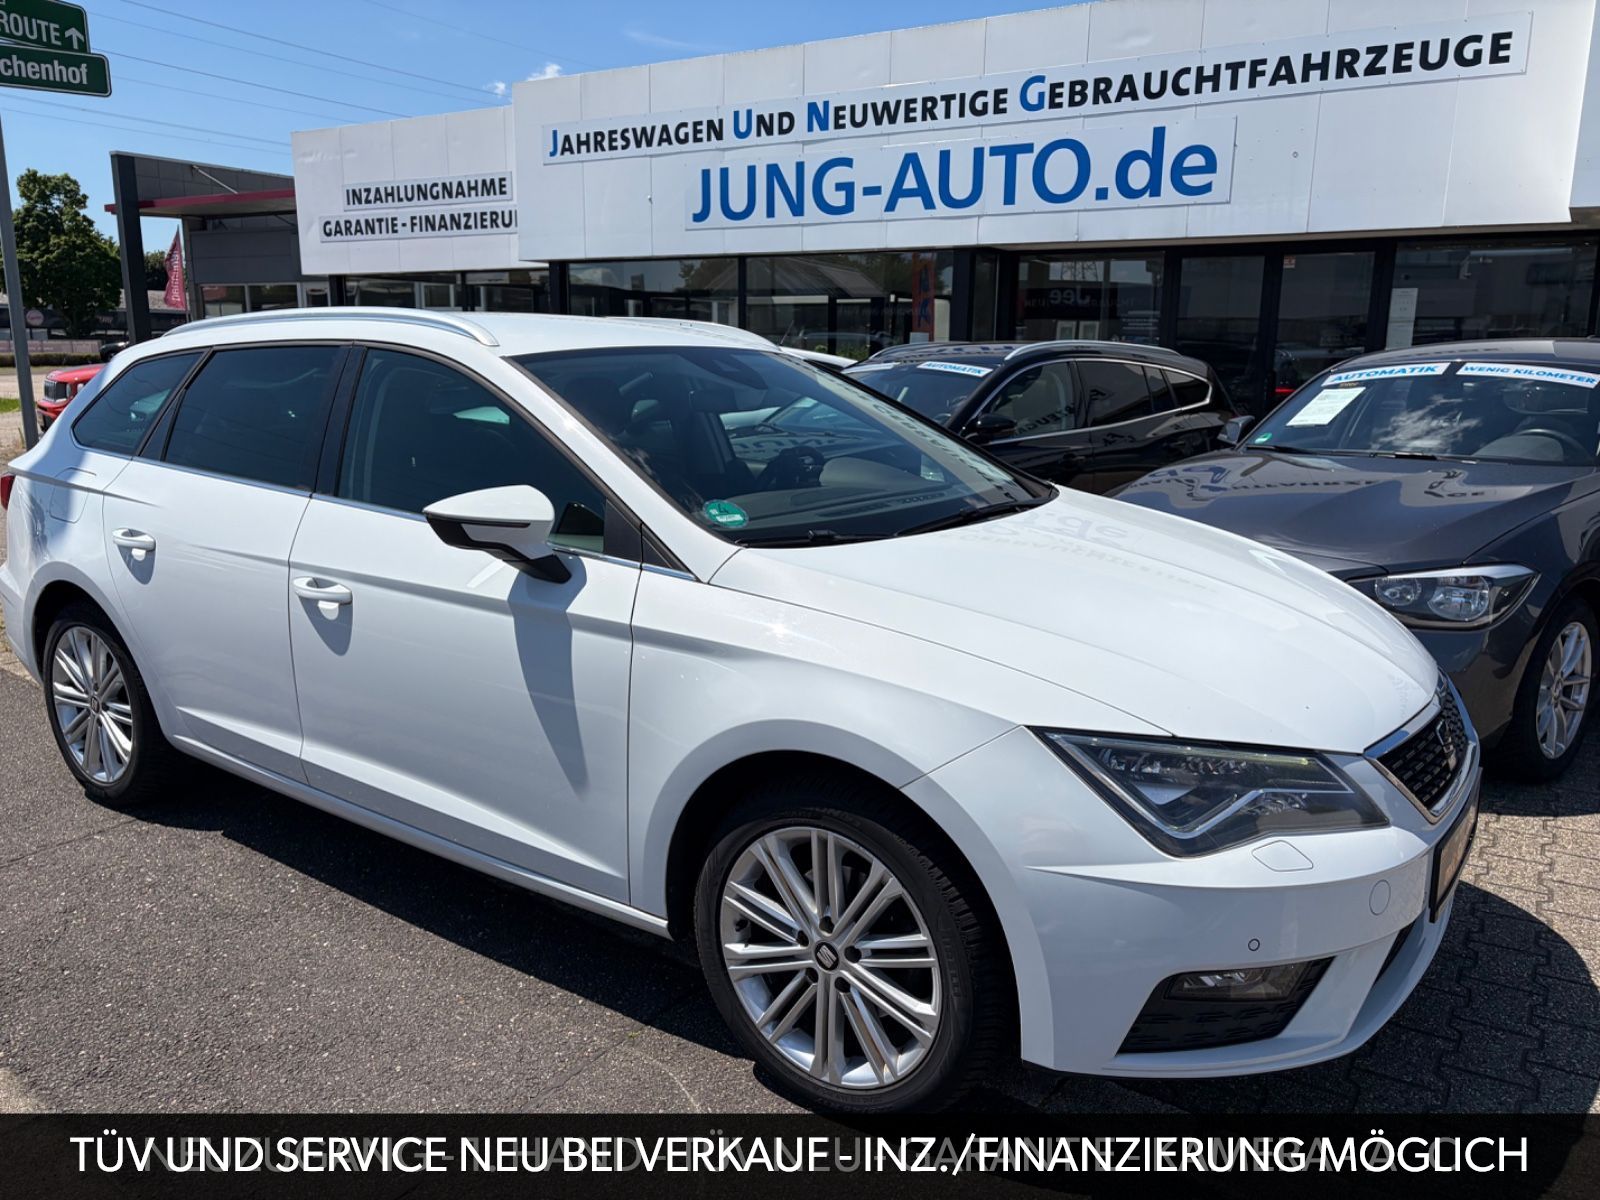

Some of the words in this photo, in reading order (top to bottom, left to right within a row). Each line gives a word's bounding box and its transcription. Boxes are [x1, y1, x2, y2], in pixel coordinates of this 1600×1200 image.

[0, 54, 88, 85] chenhof
[549, 117, 724, 157] JAHRESWAGEN
[733, 108, 796, 139] UND
[807, 88, 1008, 132] NEUWERTIGE
[1019, 31, 1513, 112] GEBRAUCHTFAHRZEUGE
[692, 126, 1218, 223] JUNG-AUTO.de
[346, 177, 507, 206] INZAHLUNGNAHME
[926, 362, 984, 375] AUTOMATIK
[1333, 365, 1440, 382] AUTOMATIK
[1463, 365, 1509, 374] WENIG
[1513, 368, 1596, 384] KILOMETER
